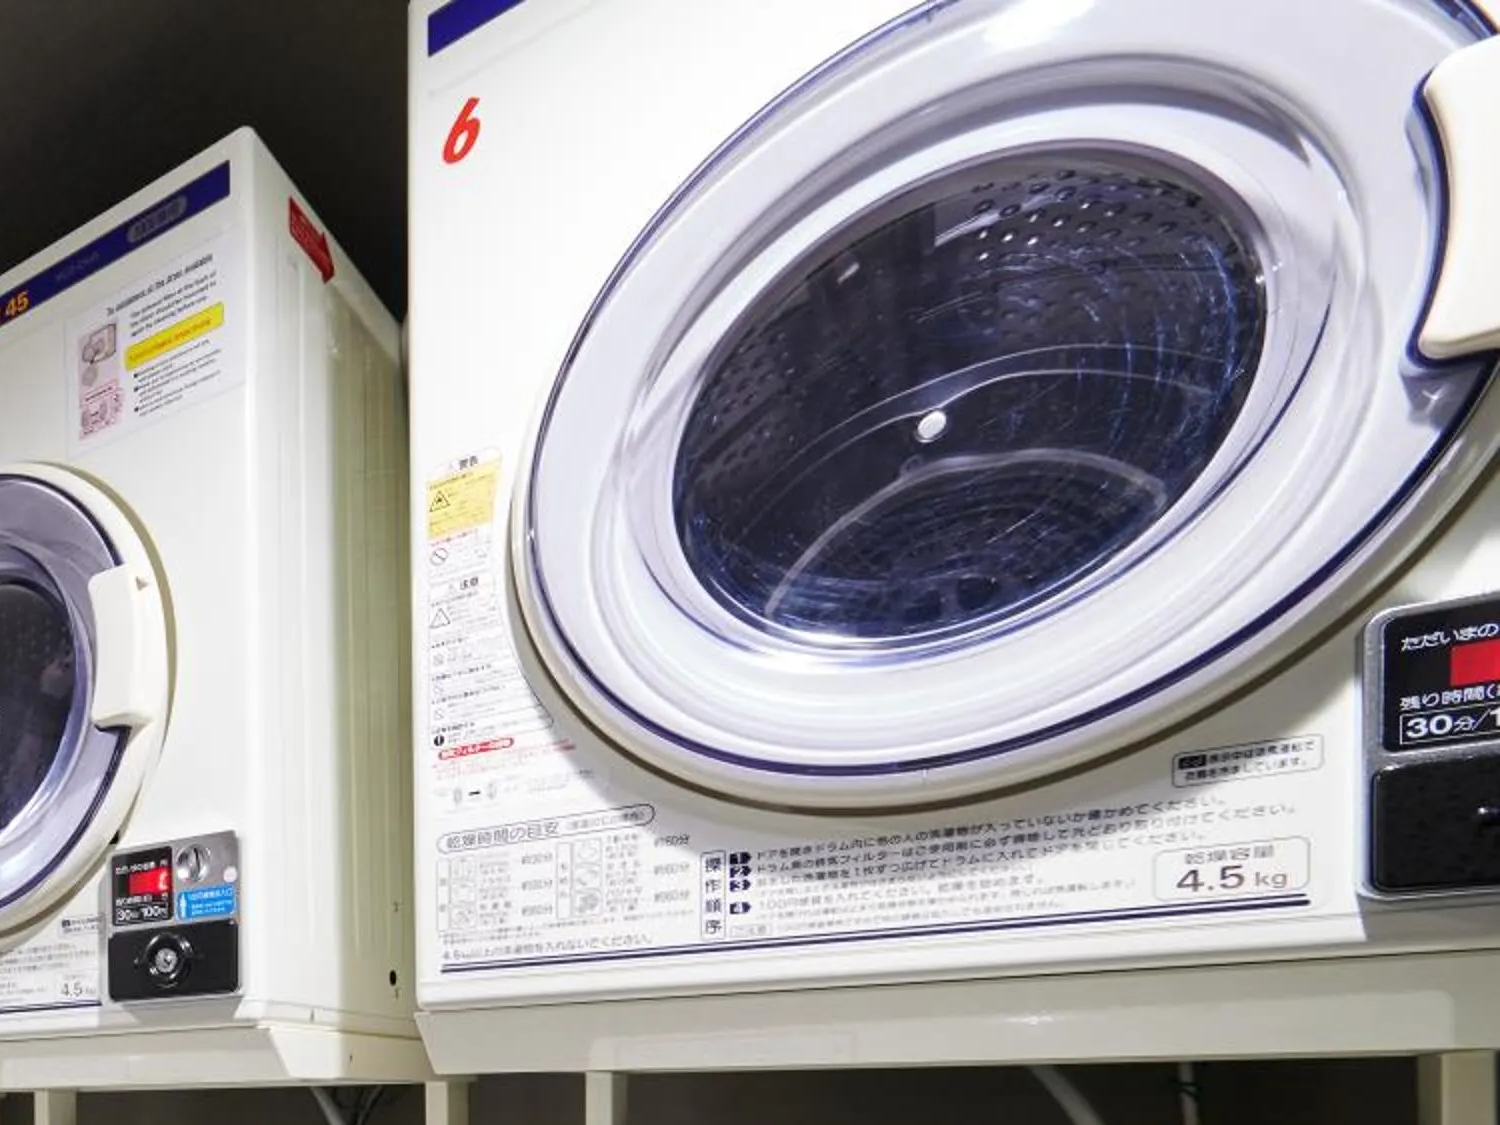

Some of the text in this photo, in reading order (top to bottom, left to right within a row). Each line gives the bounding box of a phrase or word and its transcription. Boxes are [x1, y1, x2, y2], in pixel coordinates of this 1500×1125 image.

[443, 97, 481, 164] 6
[5, 291, 30, 317] 45
[1176, 865, 1288, 892] 4.5 kg
